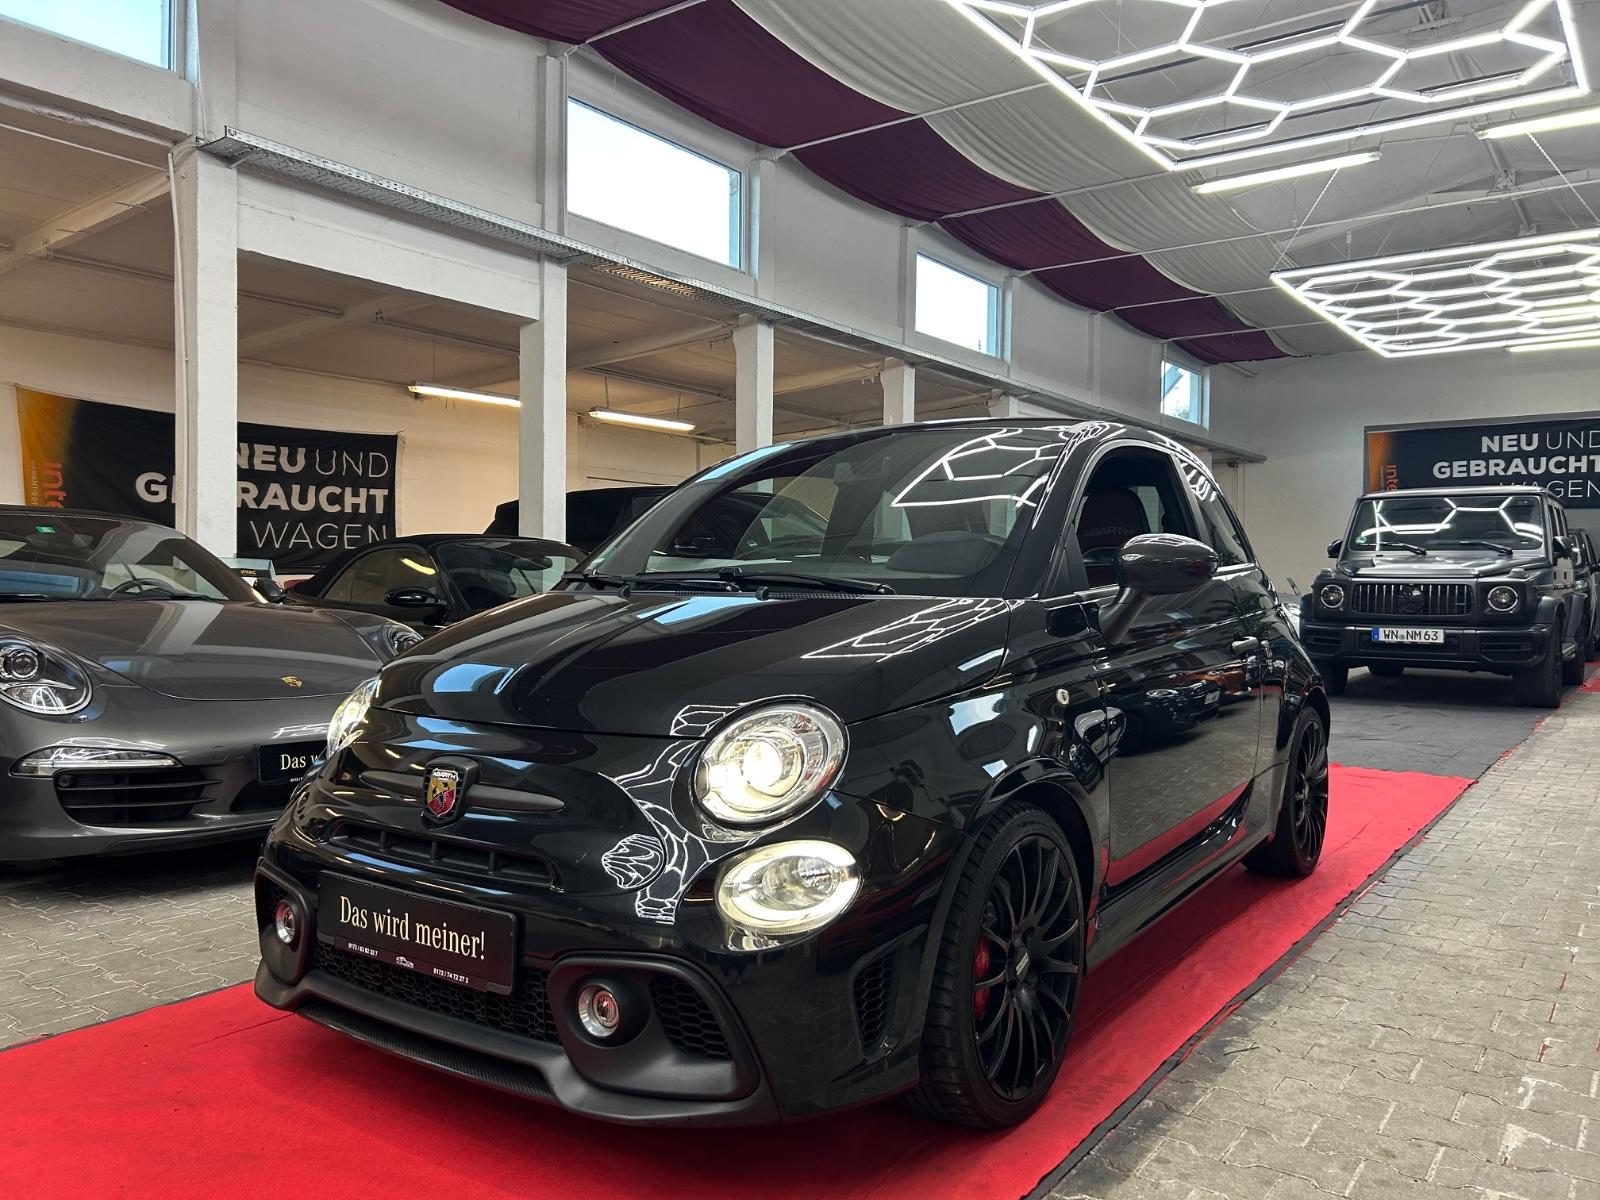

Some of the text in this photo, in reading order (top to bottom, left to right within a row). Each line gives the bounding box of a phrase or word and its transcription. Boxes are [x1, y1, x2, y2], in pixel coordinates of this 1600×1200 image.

[1481, 430, 1600, 453] NEU UND
[315, 448, 389, 478] UND
[1432, 455, 1600, 479] GEBRAUCHT
[135, 471, 389, 514] GRAUCHT
[249, 520, 387, 550] WAGEN
[1383, 629, 1438, 641] WN NM 63
[280, 753, 306, 770] Das
[340, 895, 485, 960] Das wird meiner!
